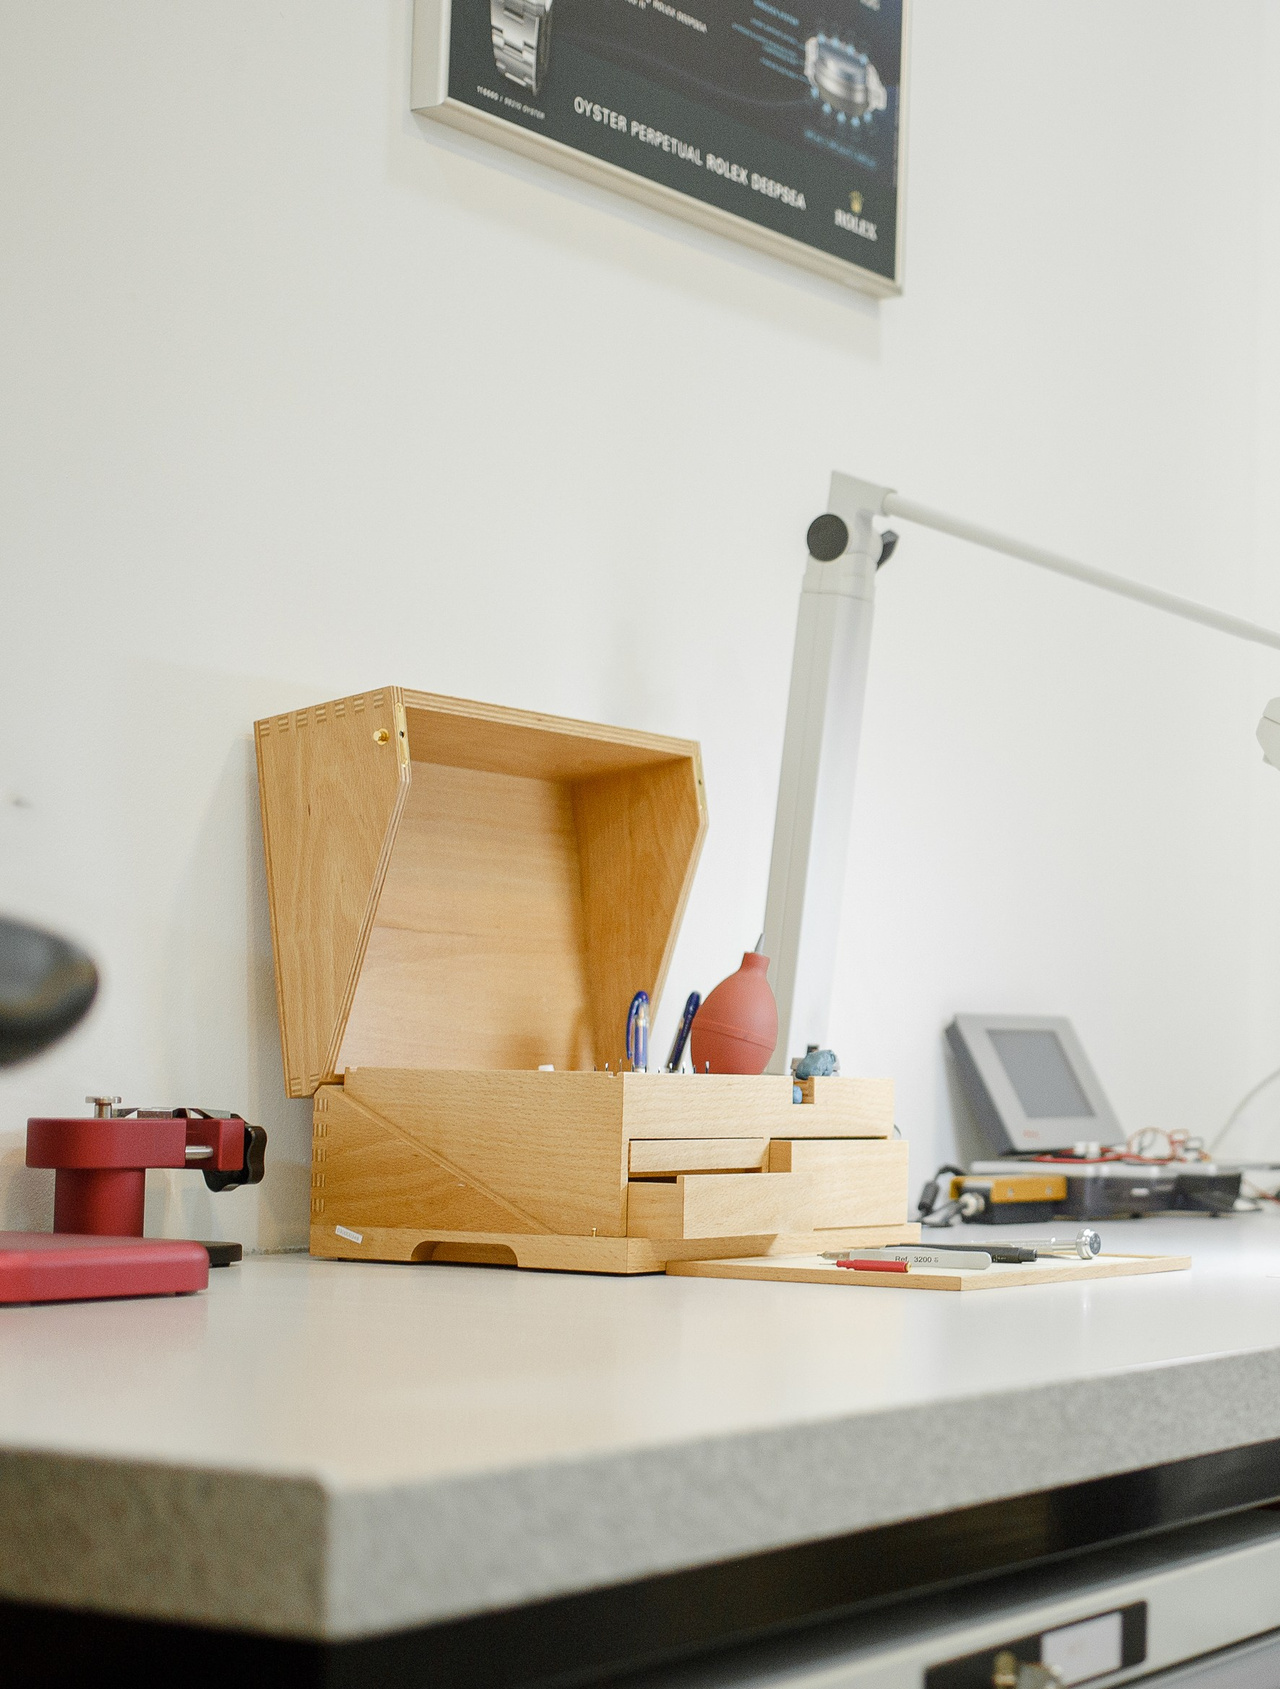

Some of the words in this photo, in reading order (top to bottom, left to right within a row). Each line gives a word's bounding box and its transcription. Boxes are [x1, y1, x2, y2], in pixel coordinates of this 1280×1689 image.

[573, 96, 627, 134] OYSTER
[630, 120, 703, 167] PERPETUAL
[705, 153, 749, 187] ROLEX
[751, 172, 807, 212] DEEPSEA
[834, 208, 878, 242] ROLEX
